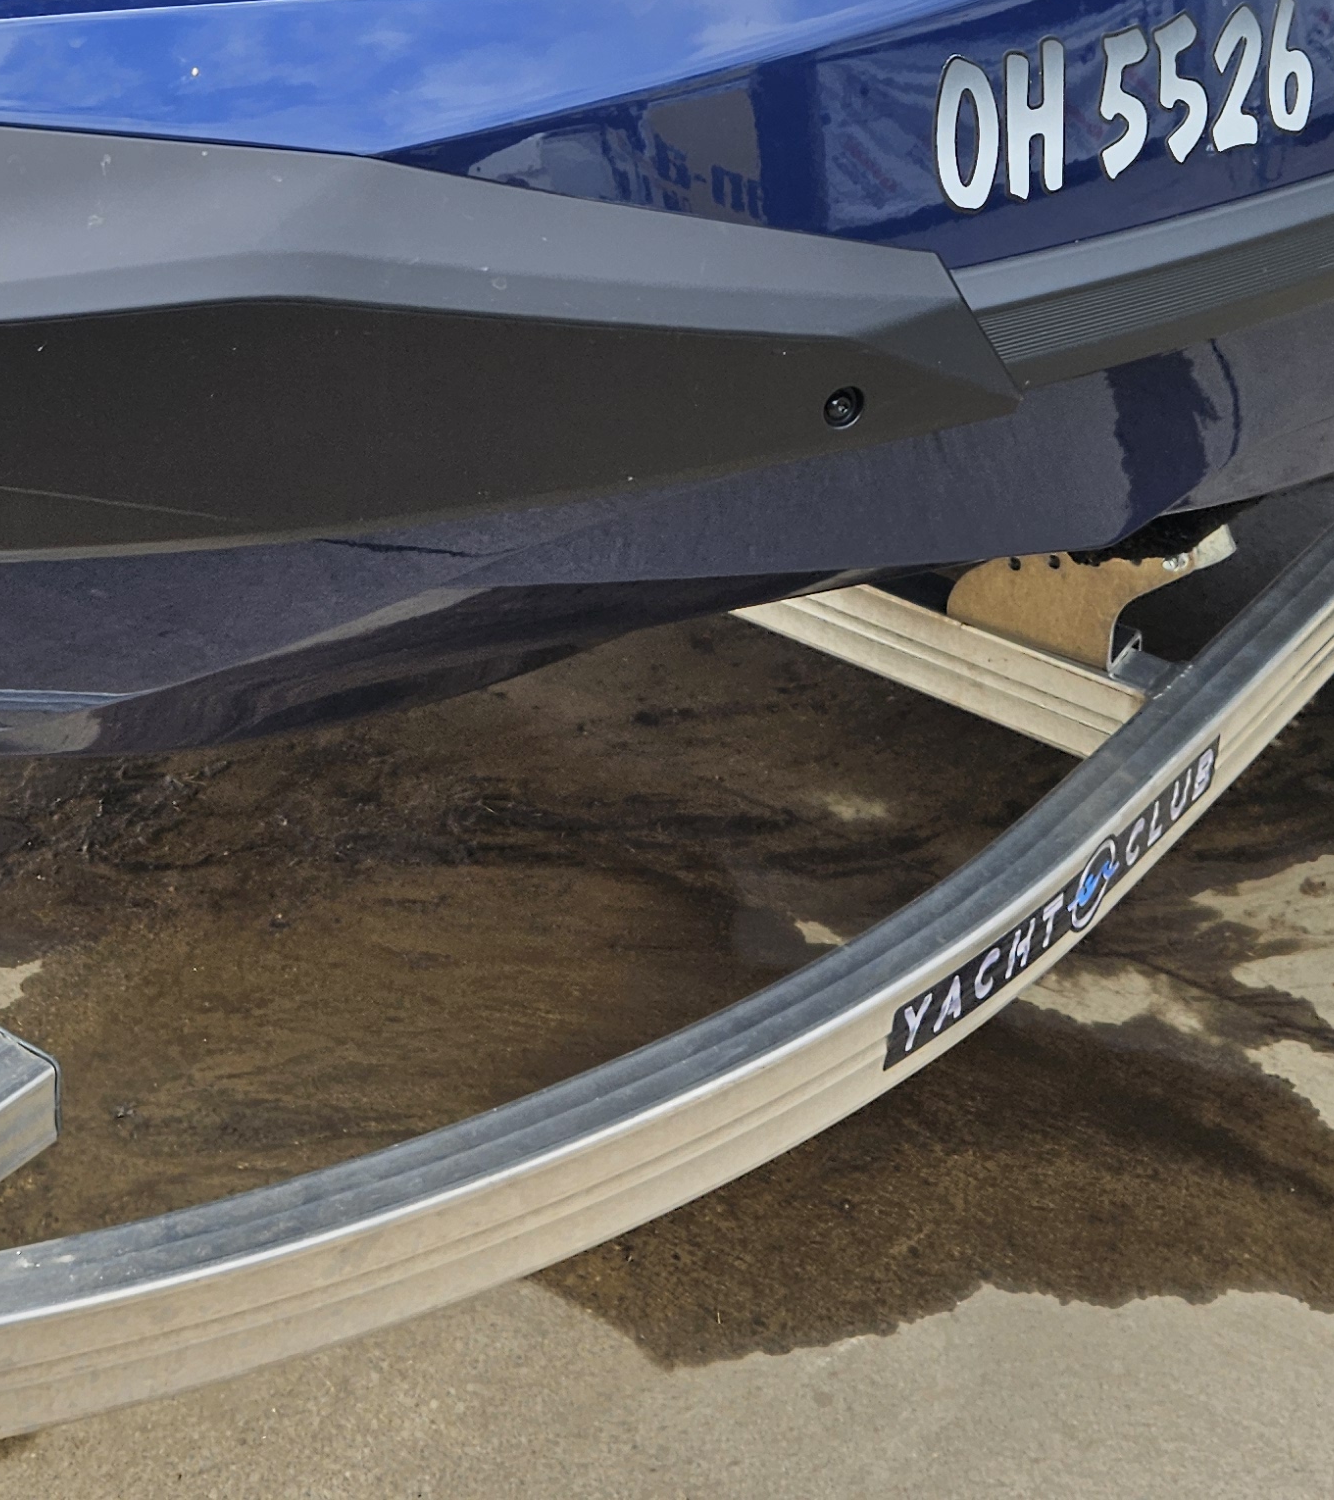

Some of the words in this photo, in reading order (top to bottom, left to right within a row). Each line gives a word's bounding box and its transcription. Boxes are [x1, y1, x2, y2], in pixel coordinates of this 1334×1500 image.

[934, 34, 1065, 212] OH
[904, 893, 1065, 1051] YACHT
[1125, 748, 1214, 866] CLUB
